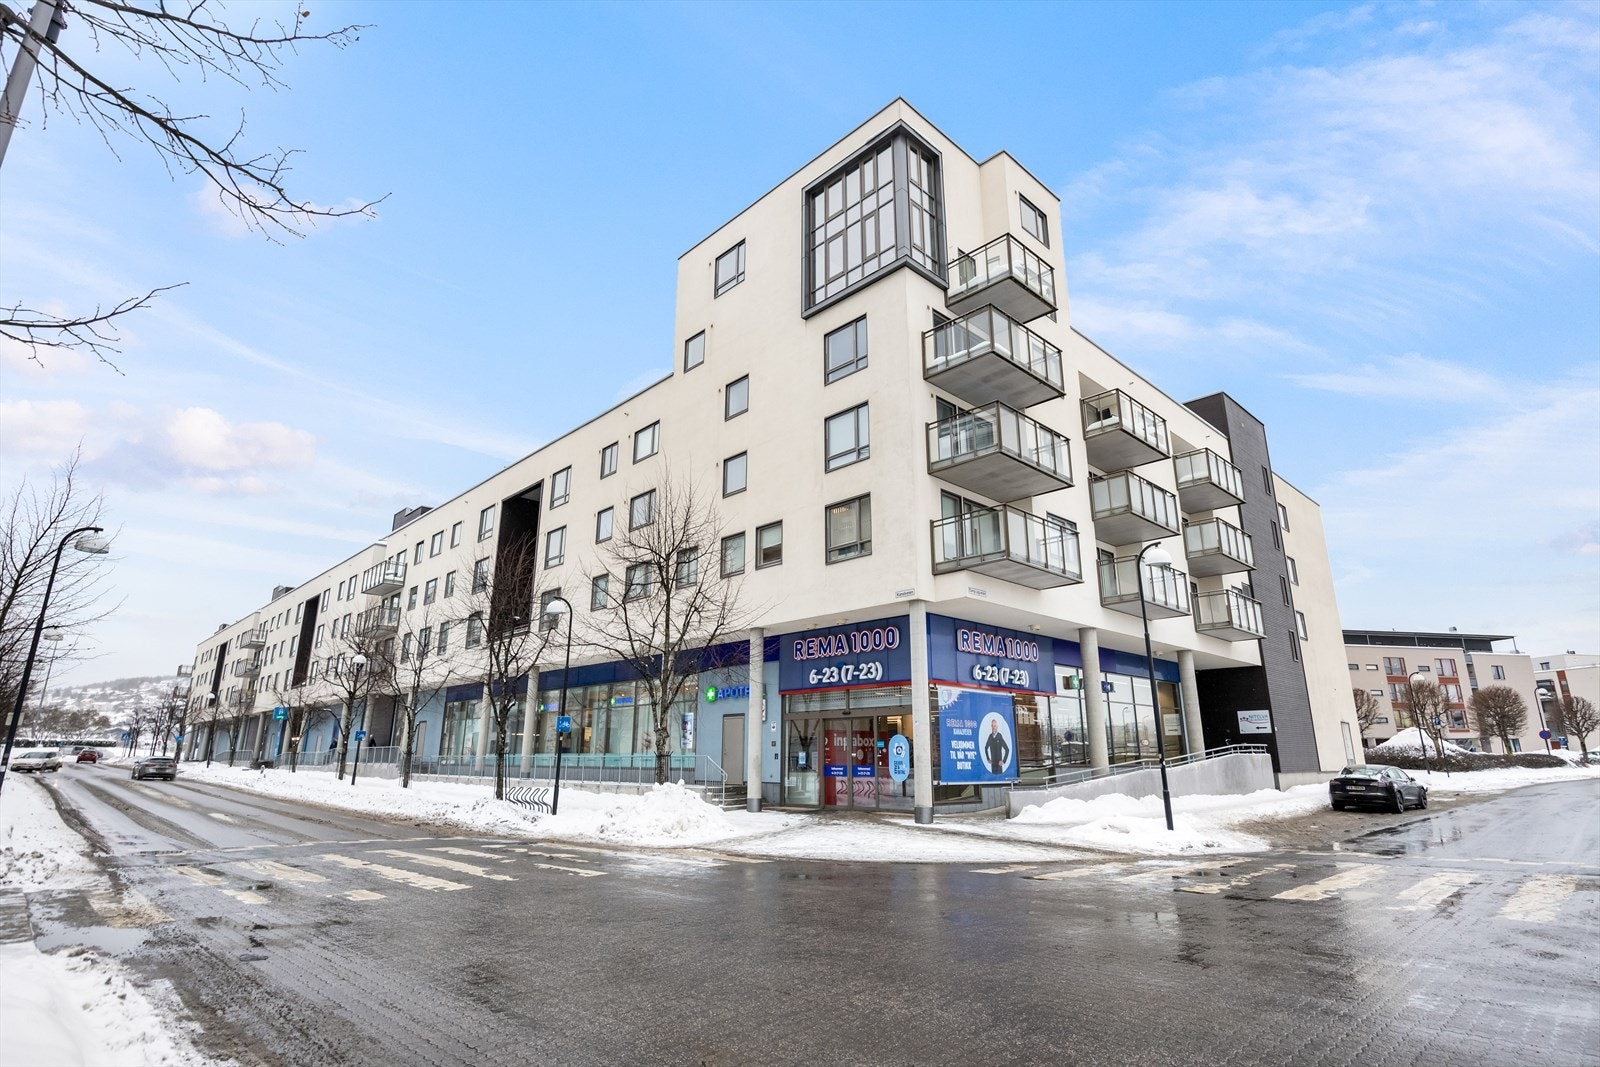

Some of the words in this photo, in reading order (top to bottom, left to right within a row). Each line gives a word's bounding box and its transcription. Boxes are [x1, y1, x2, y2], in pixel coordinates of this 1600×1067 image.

[794, 635, 849, 660] REMA
[851, 627, 899, 653] 1000
[957, 629, 1006, 657] REMA
[1005, 638, 1040, 662] 1000
[809, 666, 839, 685] 6-23
[841, 661, 883, 684] (7-23)
[973, 664, 999, 682] 6-23
[1000, 667, 1030, 688] (7-23)
[717, 686, 750, 699] APOTE
[956, 761, 972, 770] BUTIKK
